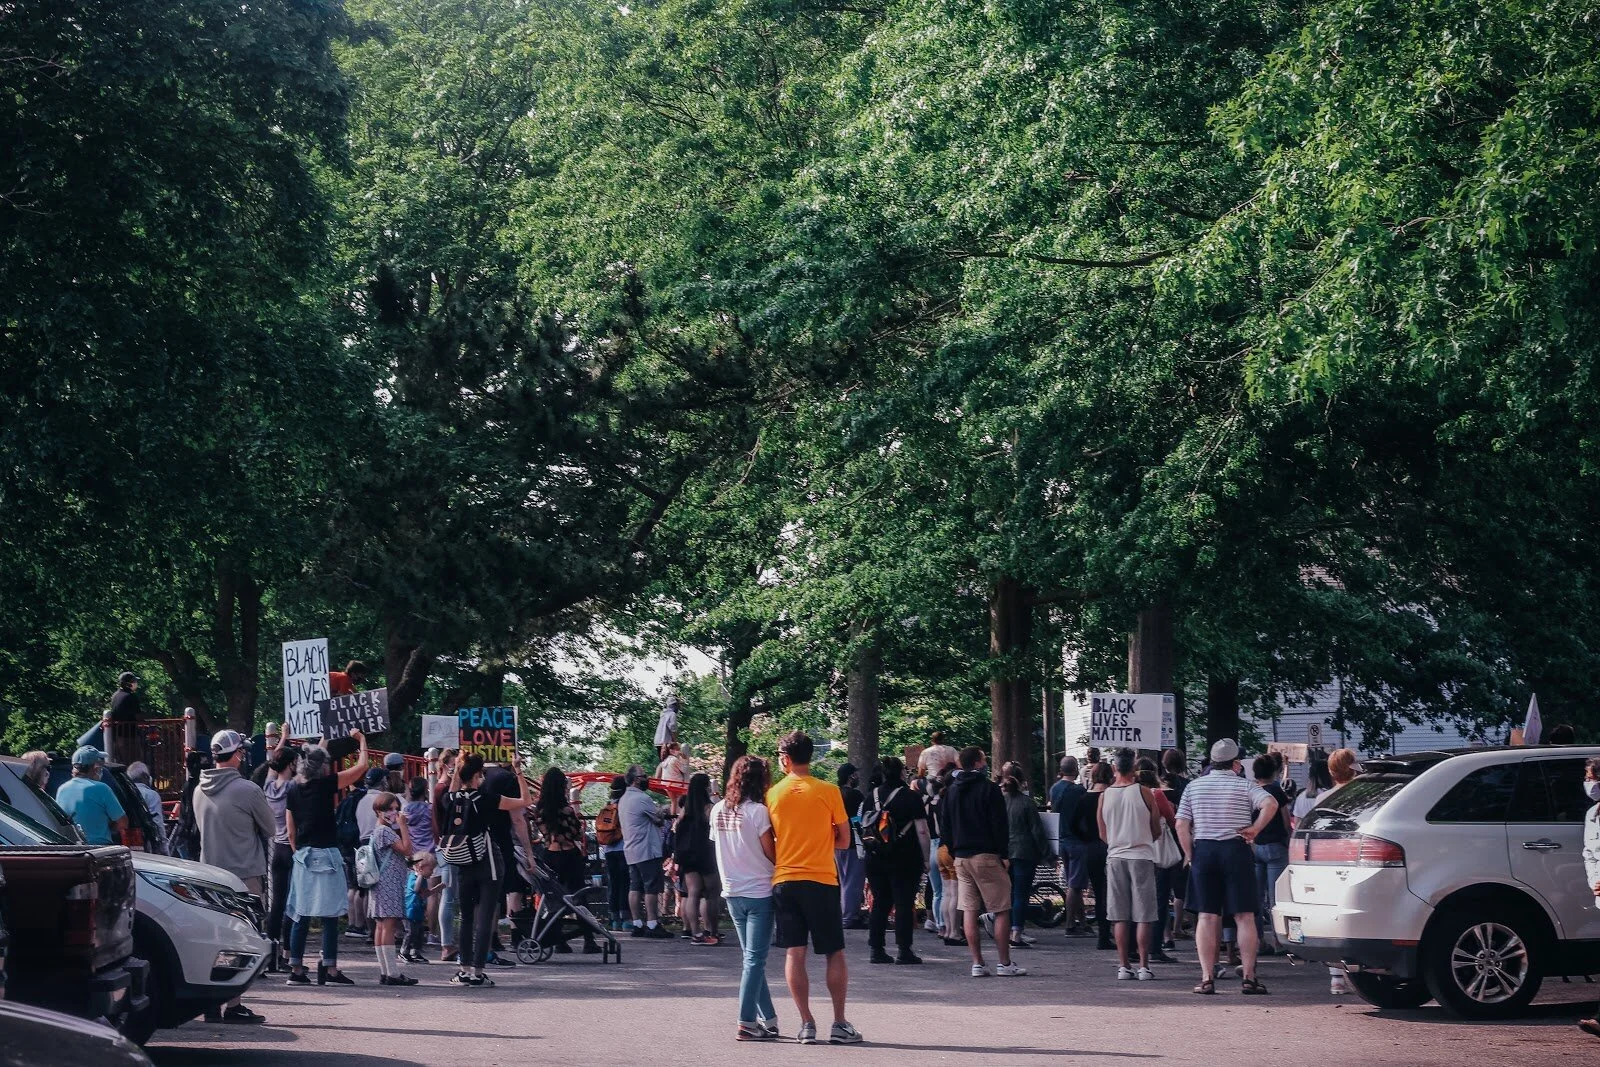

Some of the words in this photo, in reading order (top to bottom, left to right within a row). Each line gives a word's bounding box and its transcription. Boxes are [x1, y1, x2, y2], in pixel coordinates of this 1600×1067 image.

[285, 644, 327, 676] BLACK
[288, 677, 329, 708] LIVES
[330, 691, 381, 711] BLACK
[337, 704, 380, 722] LIVES
[1092, 697, 1137, 713] BLACK
[459, 707, 514, 729] PEACE
[1092, 713, 1129, 727] LIVES
[329, 716, 387, 740] MATTER
[460, 729, 512, 746] LOVE
[1091, 727, 1142, 742] MATTER
